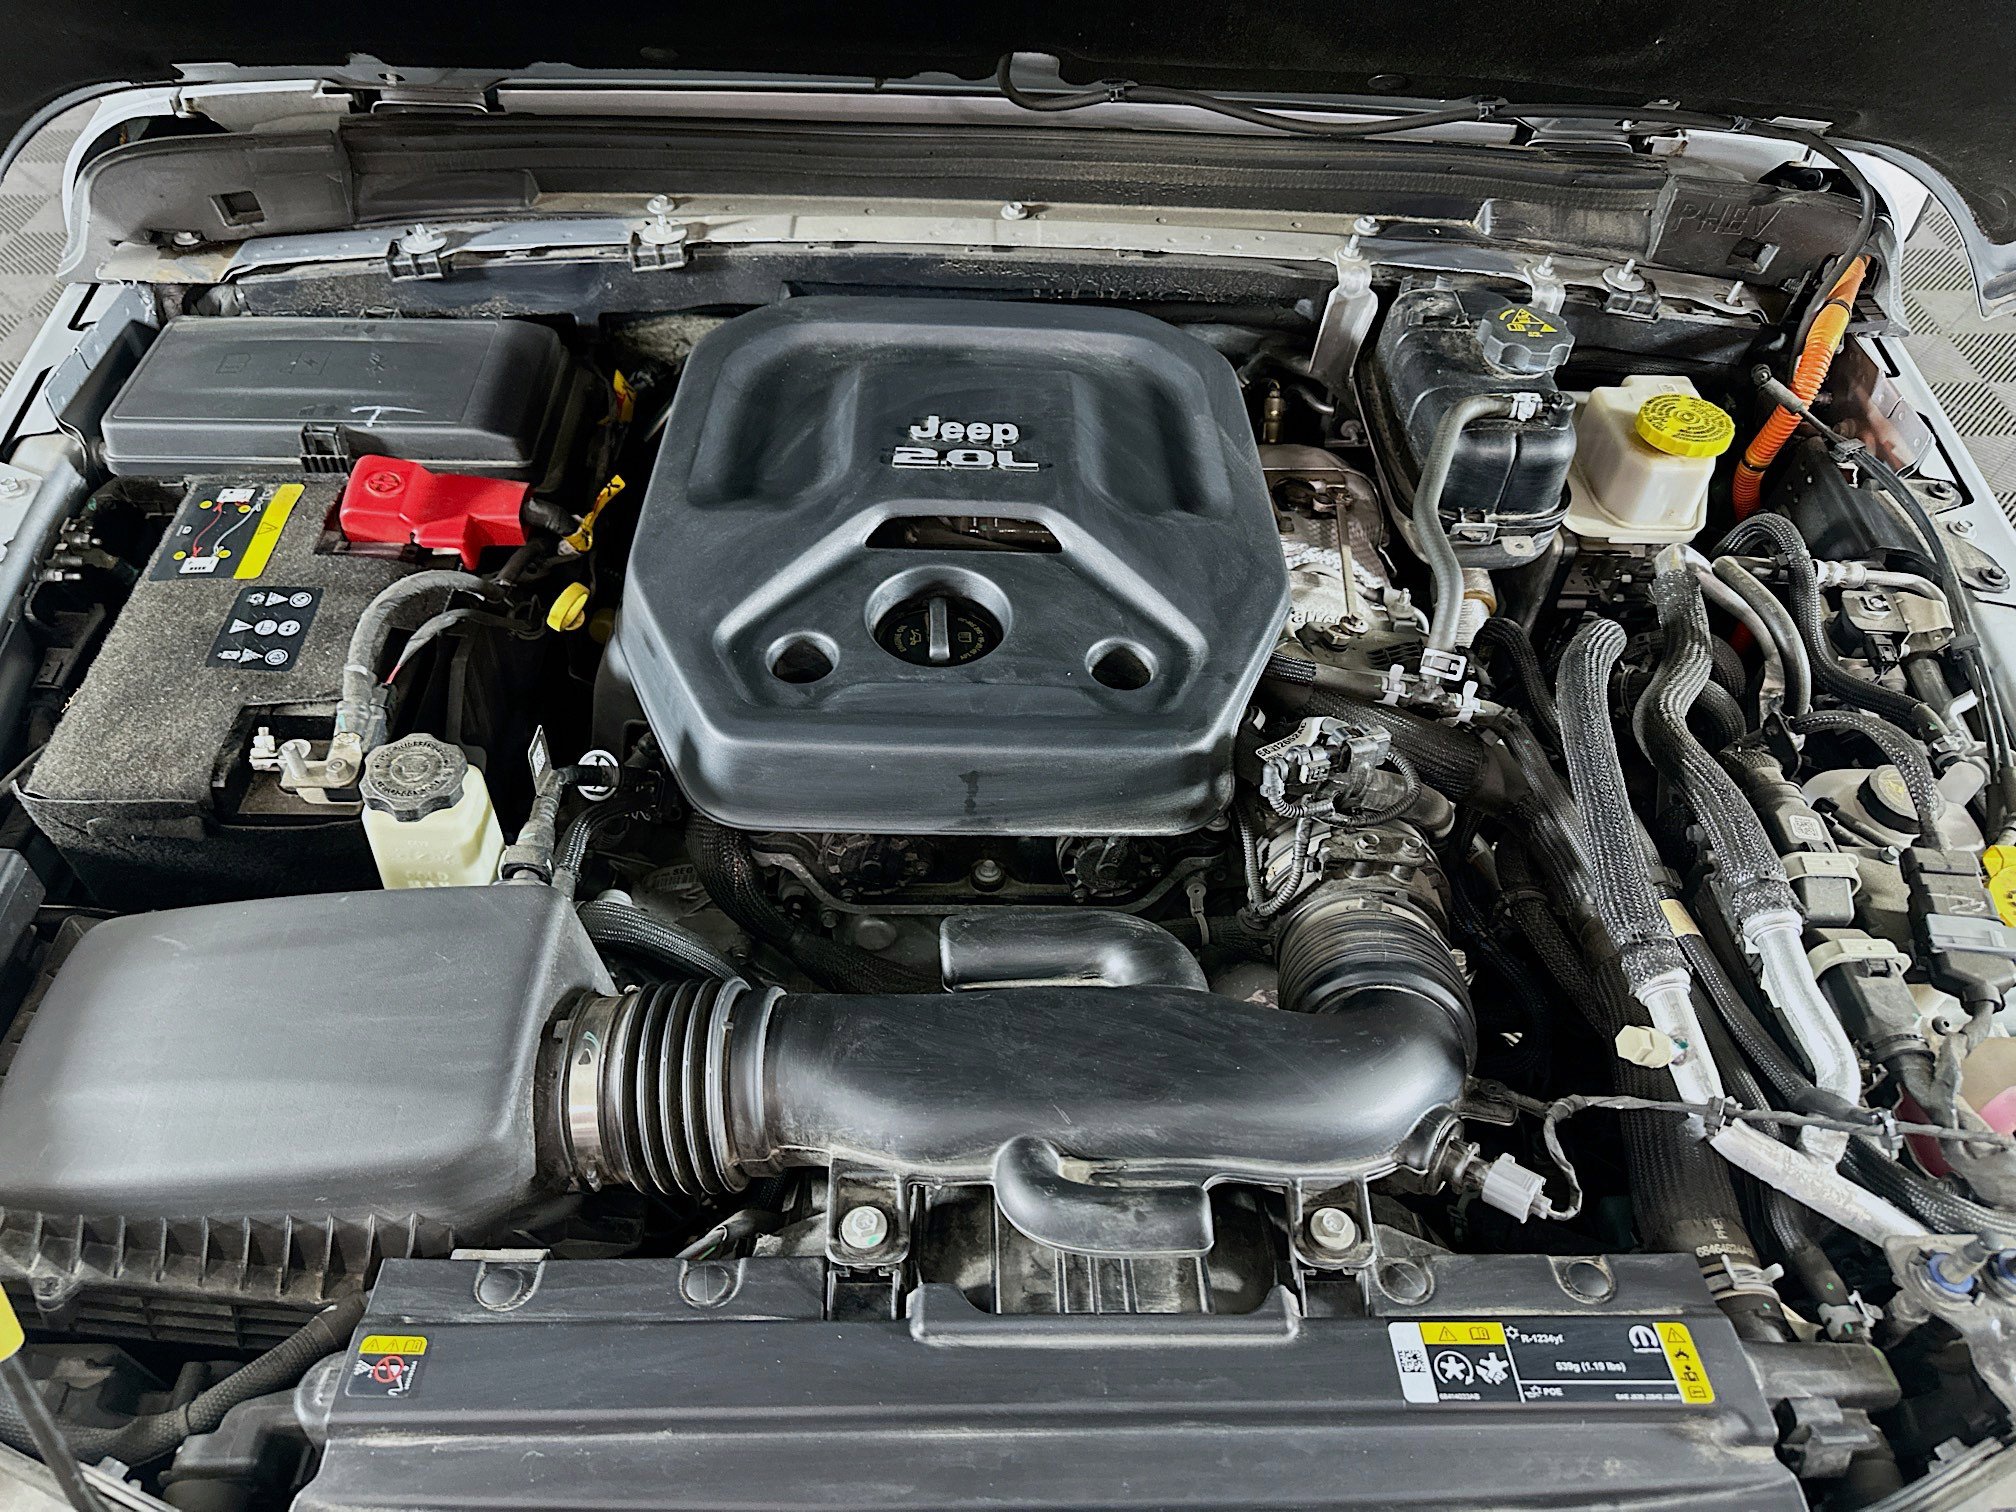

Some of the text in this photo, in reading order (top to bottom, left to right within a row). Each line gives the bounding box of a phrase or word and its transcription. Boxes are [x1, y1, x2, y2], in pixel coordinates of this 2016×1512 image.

[1673, 202, 1781, 240] PHEV
[909, 415, 1019, 448] Jeep
[892, 446, 1040, 473] 2.0L
[1520, 1333, 1565, 1345] R-1234yf
[1543, 1387, 1564, 1396] POE
